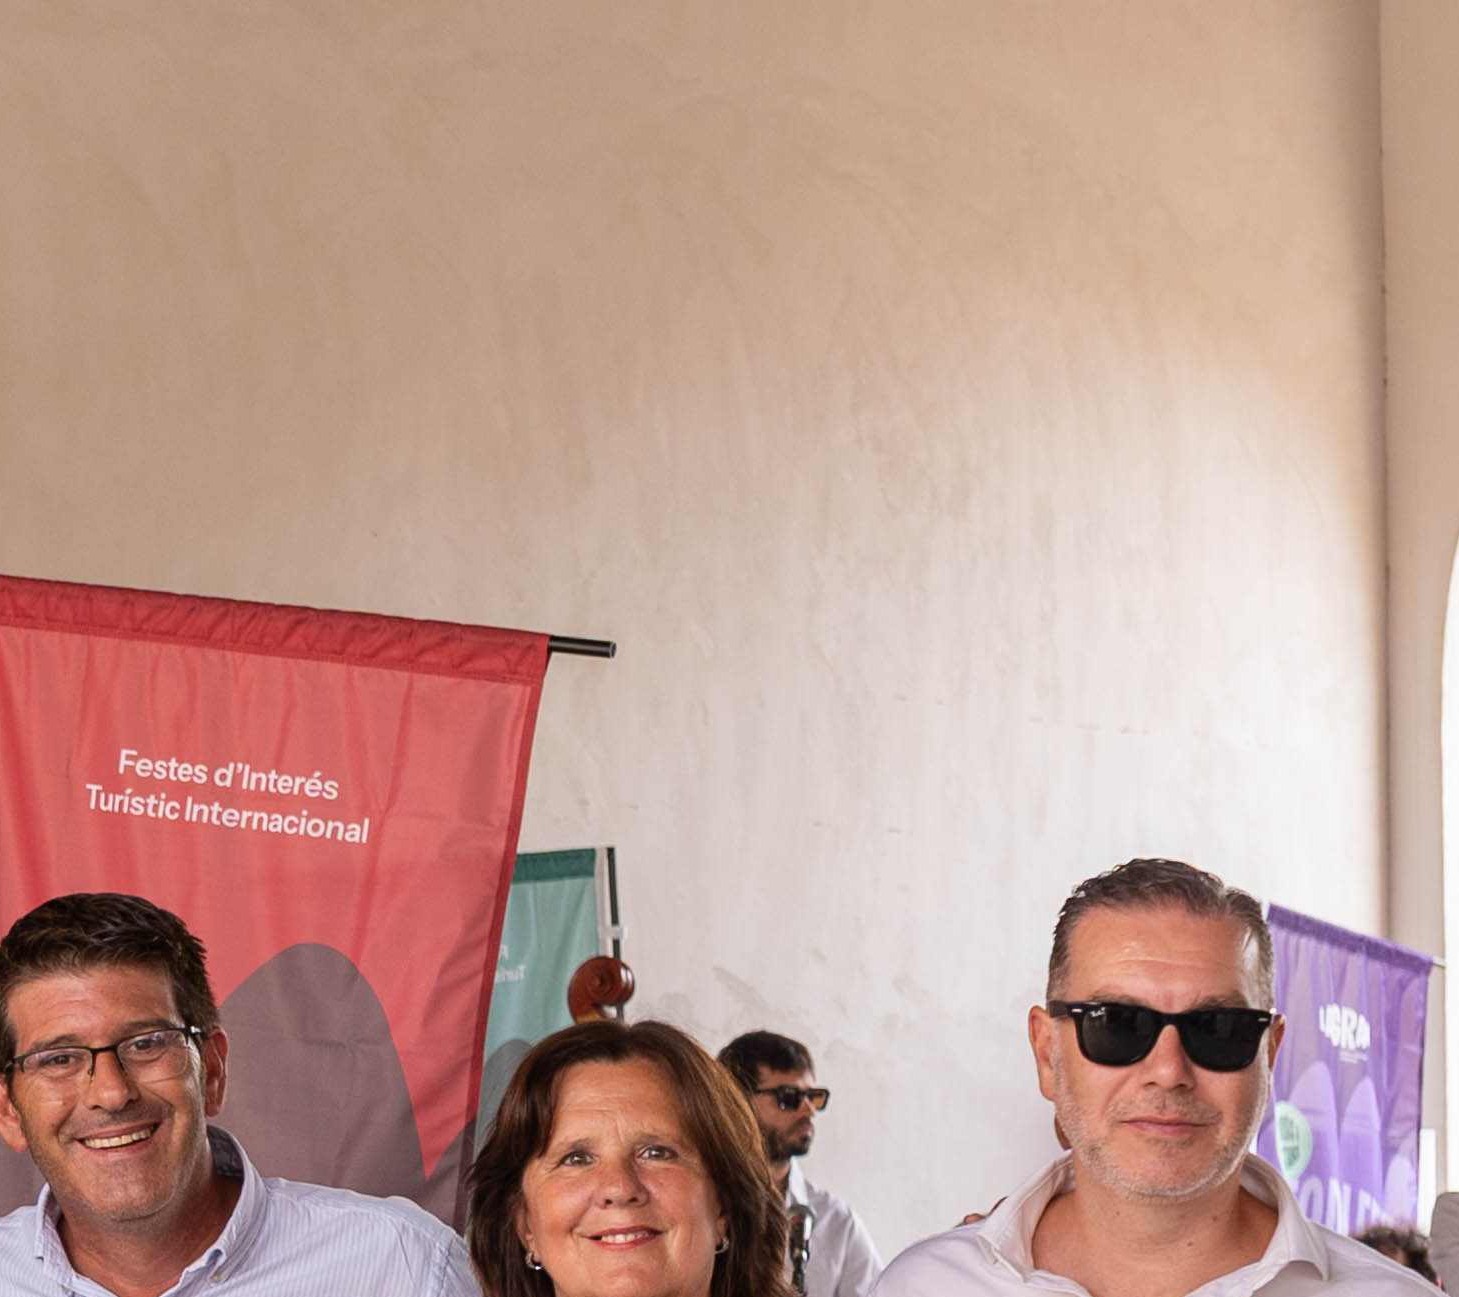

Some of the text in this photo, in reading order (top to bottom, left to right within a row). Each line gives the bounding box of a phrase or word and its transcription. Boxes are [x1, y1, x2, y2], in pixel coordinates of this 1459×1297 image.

[118, 748, 340, 801] Festes d'Interés
[85, 784, 369, 844] Turístic Internacional
